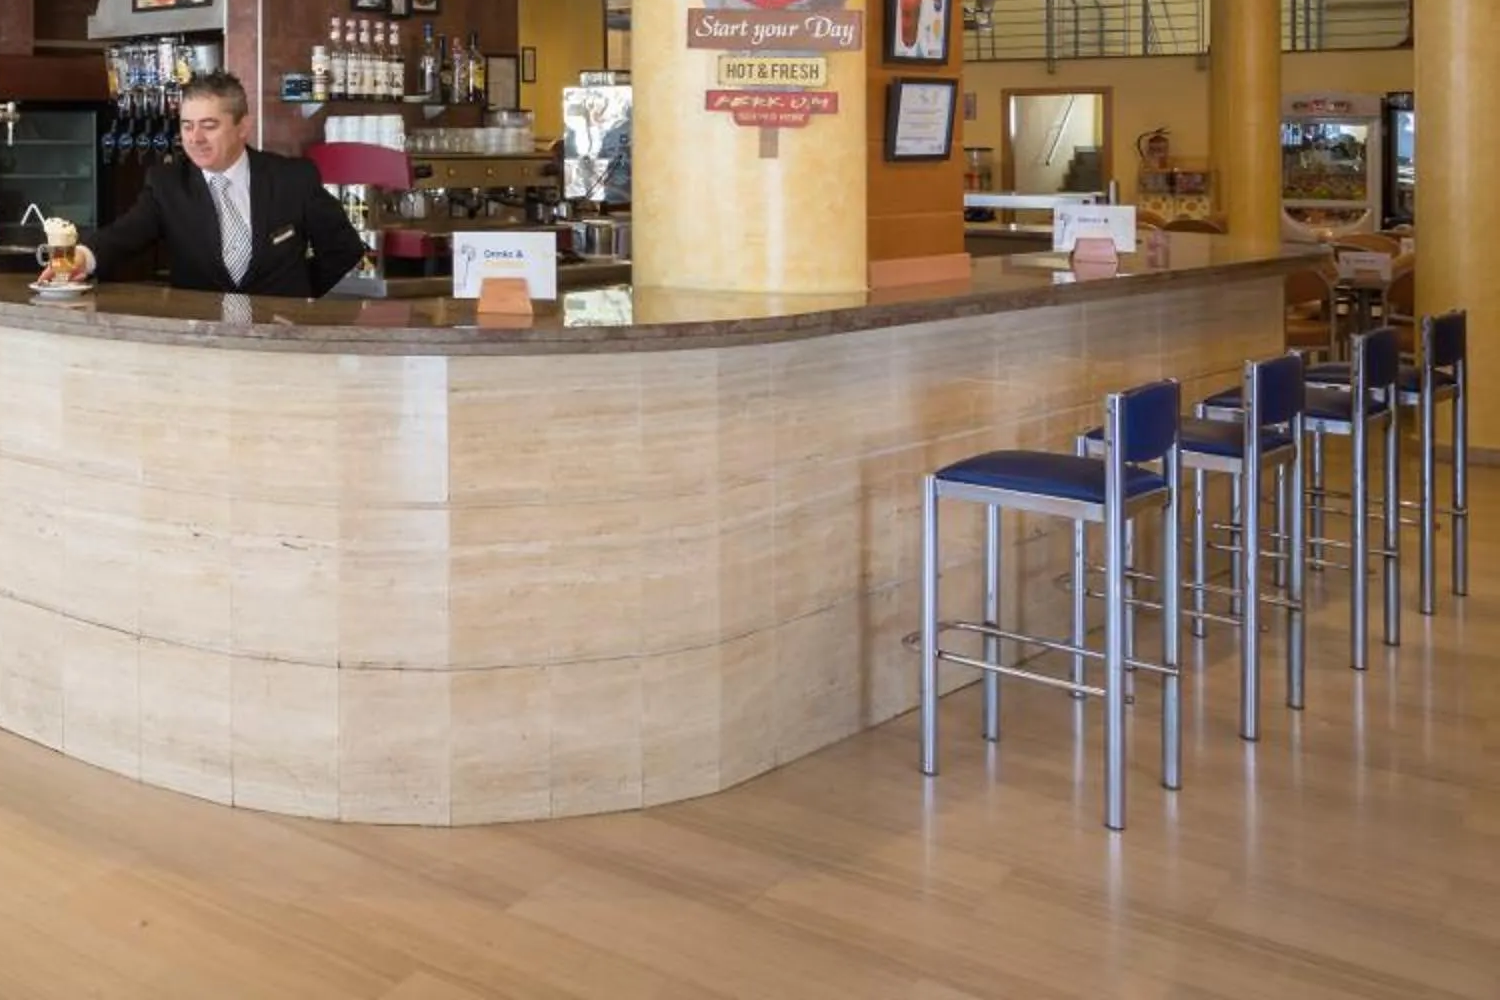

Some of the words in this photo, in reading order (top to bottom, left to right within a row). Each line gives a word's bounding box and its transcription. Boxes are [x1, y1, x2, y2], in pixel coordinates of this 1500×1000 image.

[695, 15, 749, 37] Start
[751, 23, 799, 45] your
[805, 15, 855, 45] Day
